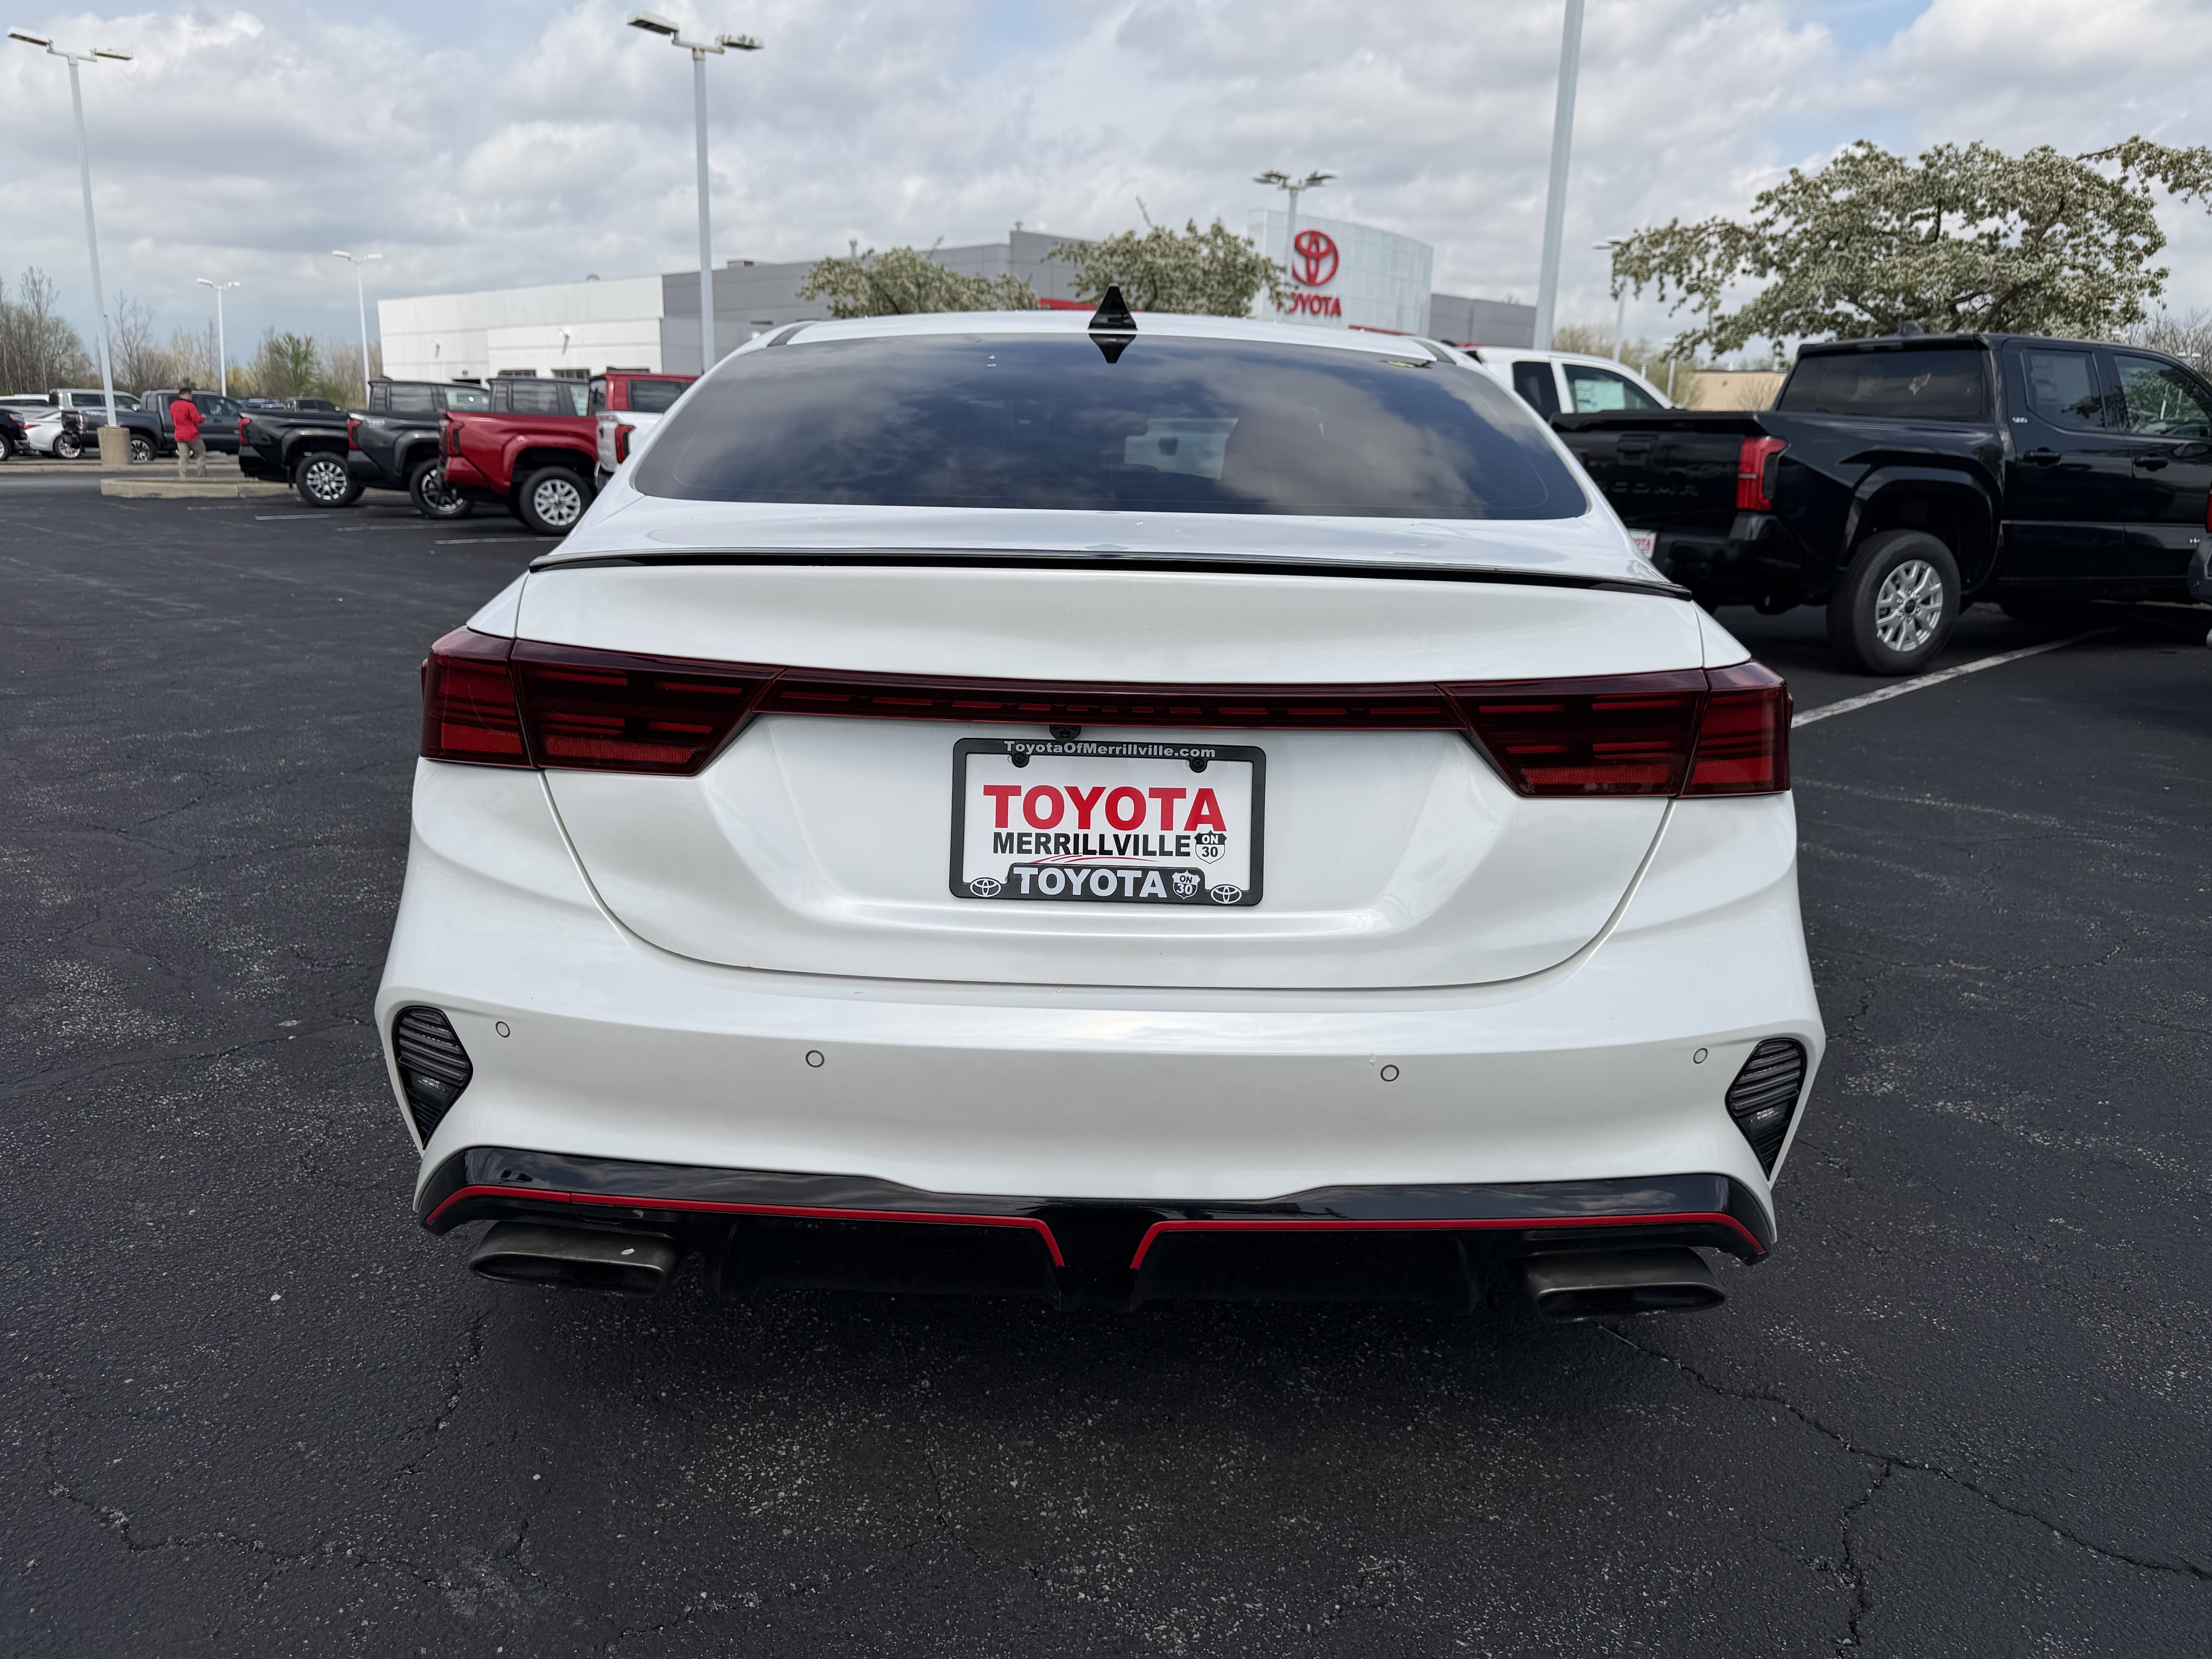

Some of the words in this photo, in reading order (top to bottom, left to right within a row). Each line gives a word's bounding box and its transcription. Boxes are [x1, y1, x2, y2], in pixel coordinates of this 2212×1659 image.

[1004, 740, 1216, 758] ToyotaOfMerrillville.com
[983, 785, 1227, 832] TOYOTA
[993, 832, 1191, 857] MERRILLVILLE
[1202, 835, 1219, 844] ON
[1202, 846, 1218, 857] 30
[1013, 867, 1168, 898] TOYOTA
[1180, 875, 1192, 883] ON
[1176, 883, 1193, 894] 30
